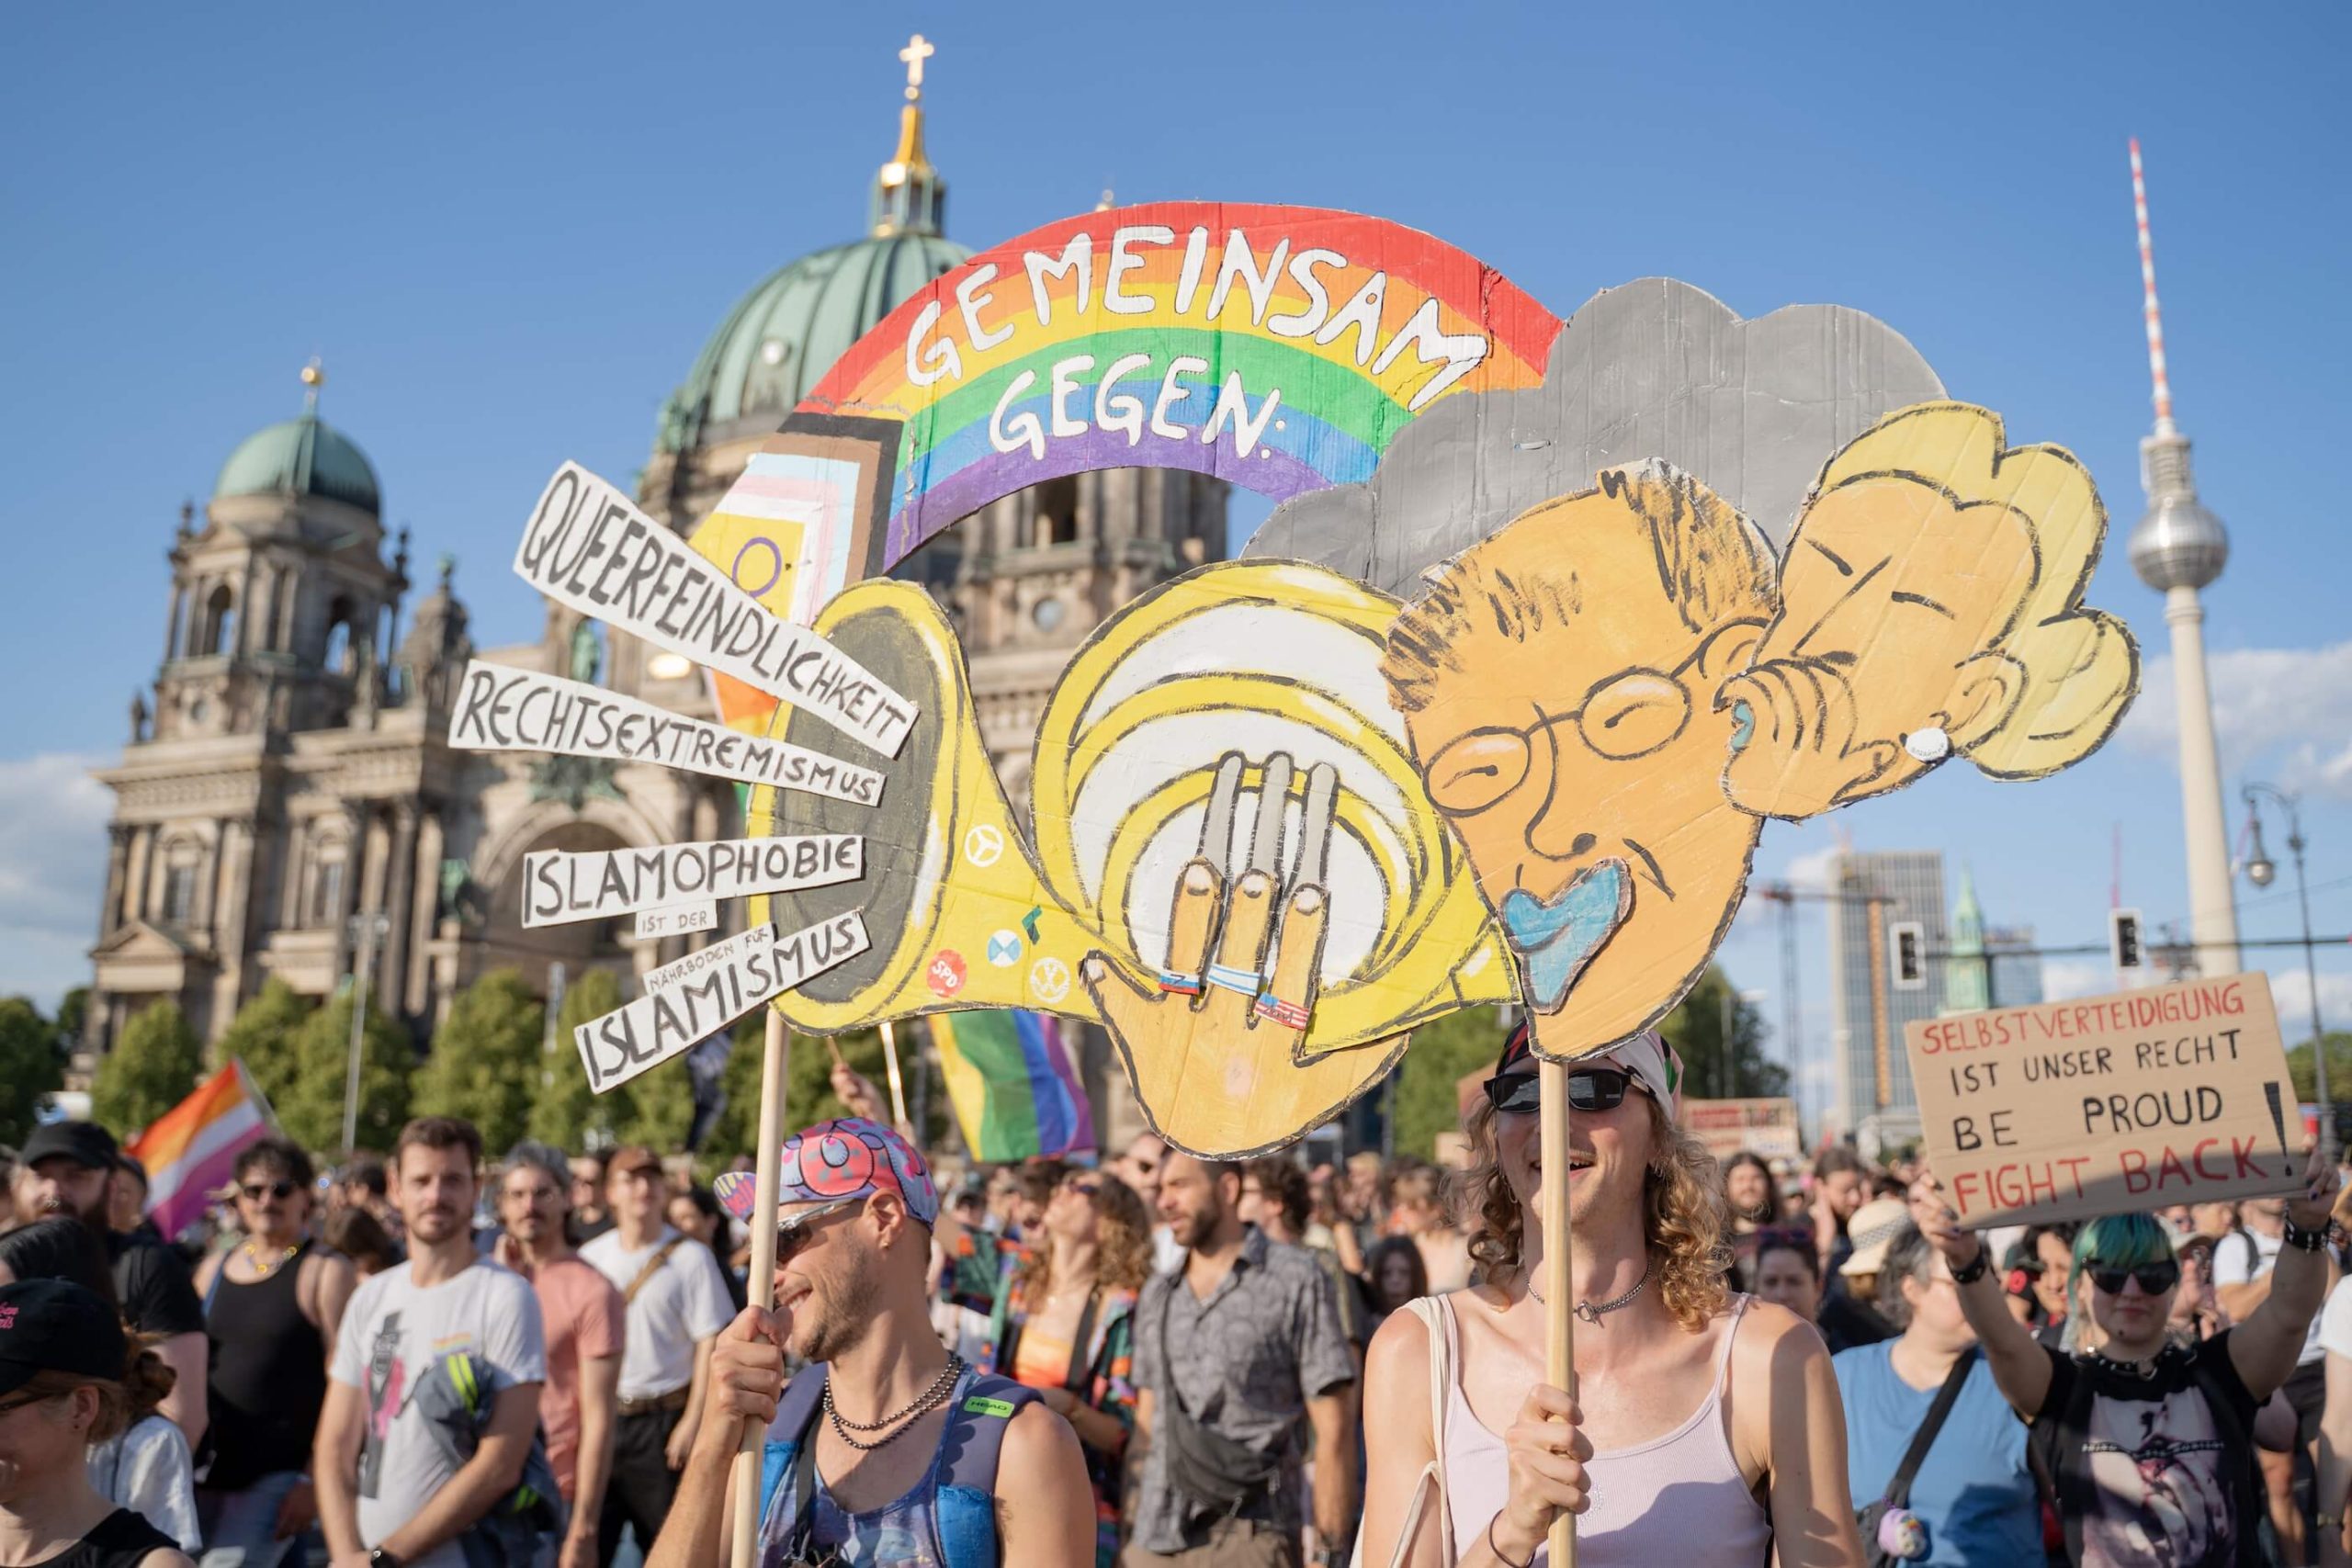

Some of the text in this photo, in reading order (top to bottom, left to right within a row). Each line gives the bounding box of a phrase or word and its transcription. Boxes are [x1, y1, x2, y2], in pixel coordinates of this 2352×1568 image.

[906, 226, 1487, 412] GEMEINSAM
[522, 469, 908, 739] QUEERFEINDLICHKEIT
[458, 670, 881, 803] RECHTSEXTREMISMUS
[524, 836, 857, 922] ISLAMOPHOBIE
[642, 910, 707, 932] IST DER
[650, 927, 769, 990] NÄHRBODEN FÜR
[931, 960, 958, 988] SPD
[1922, 982, 2245, 1055] SELBSTVERTEIDIGUNG
[1951, 1029, 2241, 1096] IST UNSER RECHT
[1953, 1087, 2222, 1151] BE PROUD
[1953, 1156, 2091, 1214] FIGHT
[2120, 1134, 2268, 1194] BACK
